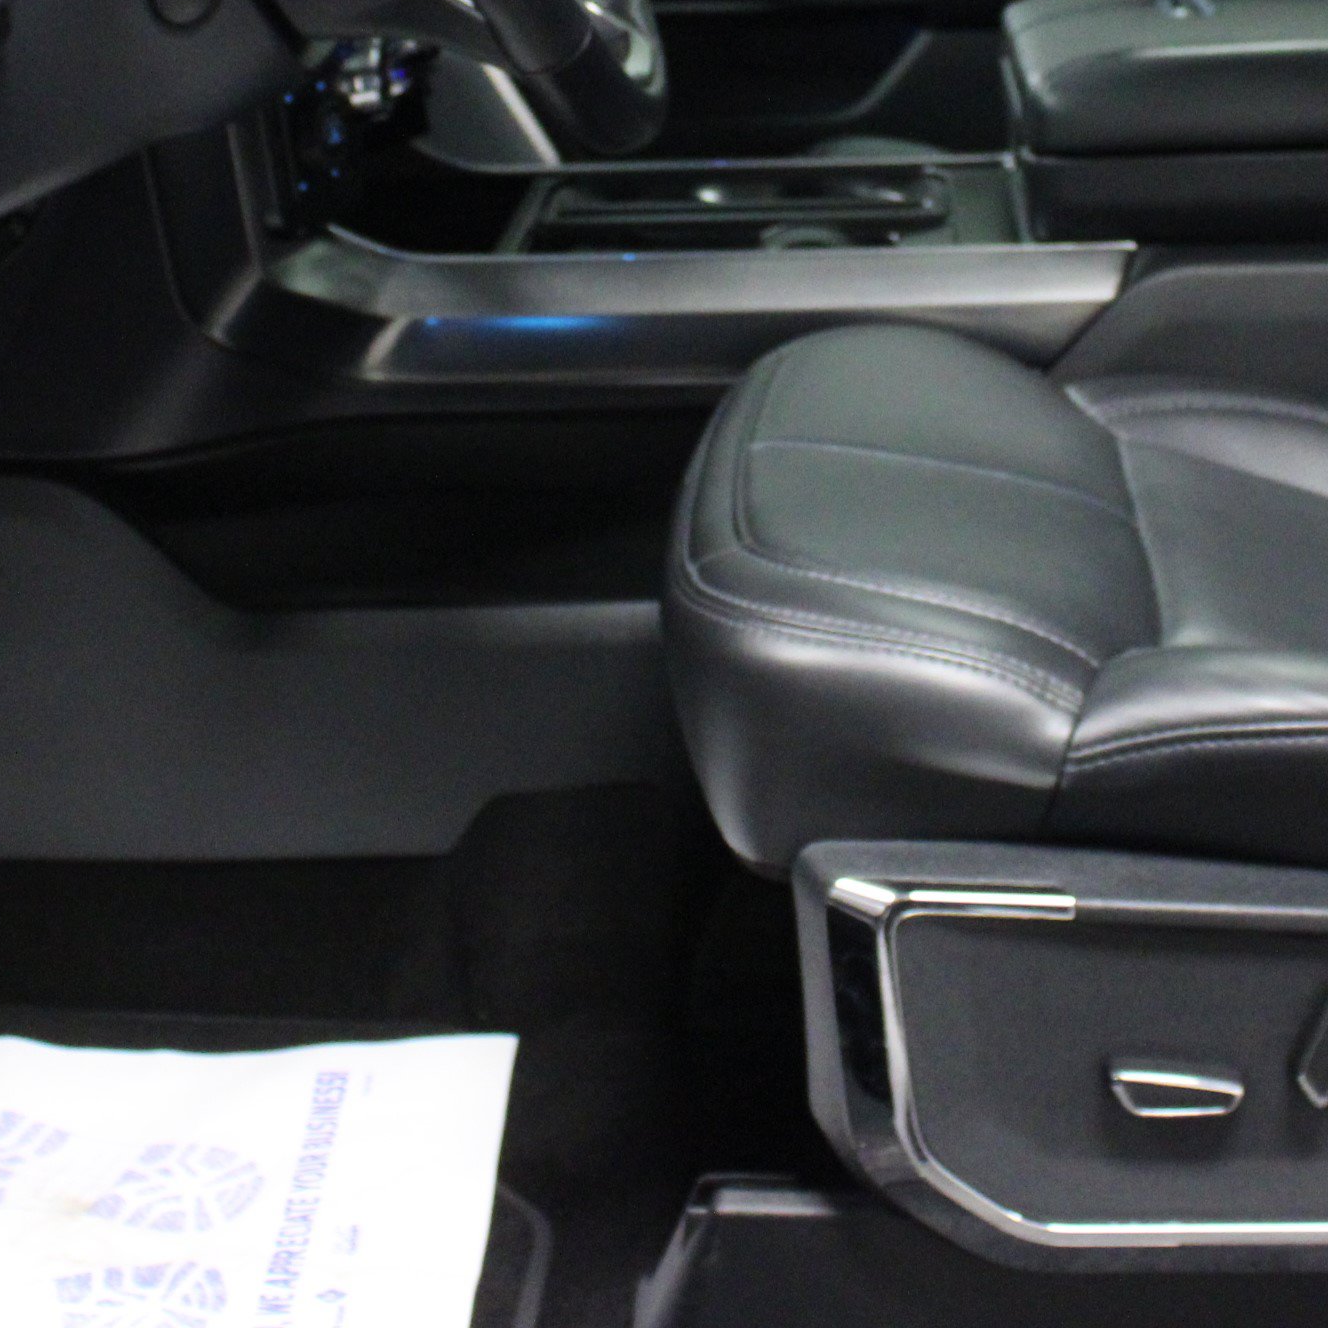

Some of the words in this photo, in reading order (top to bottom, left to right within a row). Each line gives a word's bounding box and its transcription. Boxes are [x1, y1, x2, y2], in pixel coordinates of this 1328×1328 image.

[289, 1152, 329, 1193] YOUR
[264, 1197, 321, 1289] APPRECIATE
[257, 1293, 295, 1315] WE
